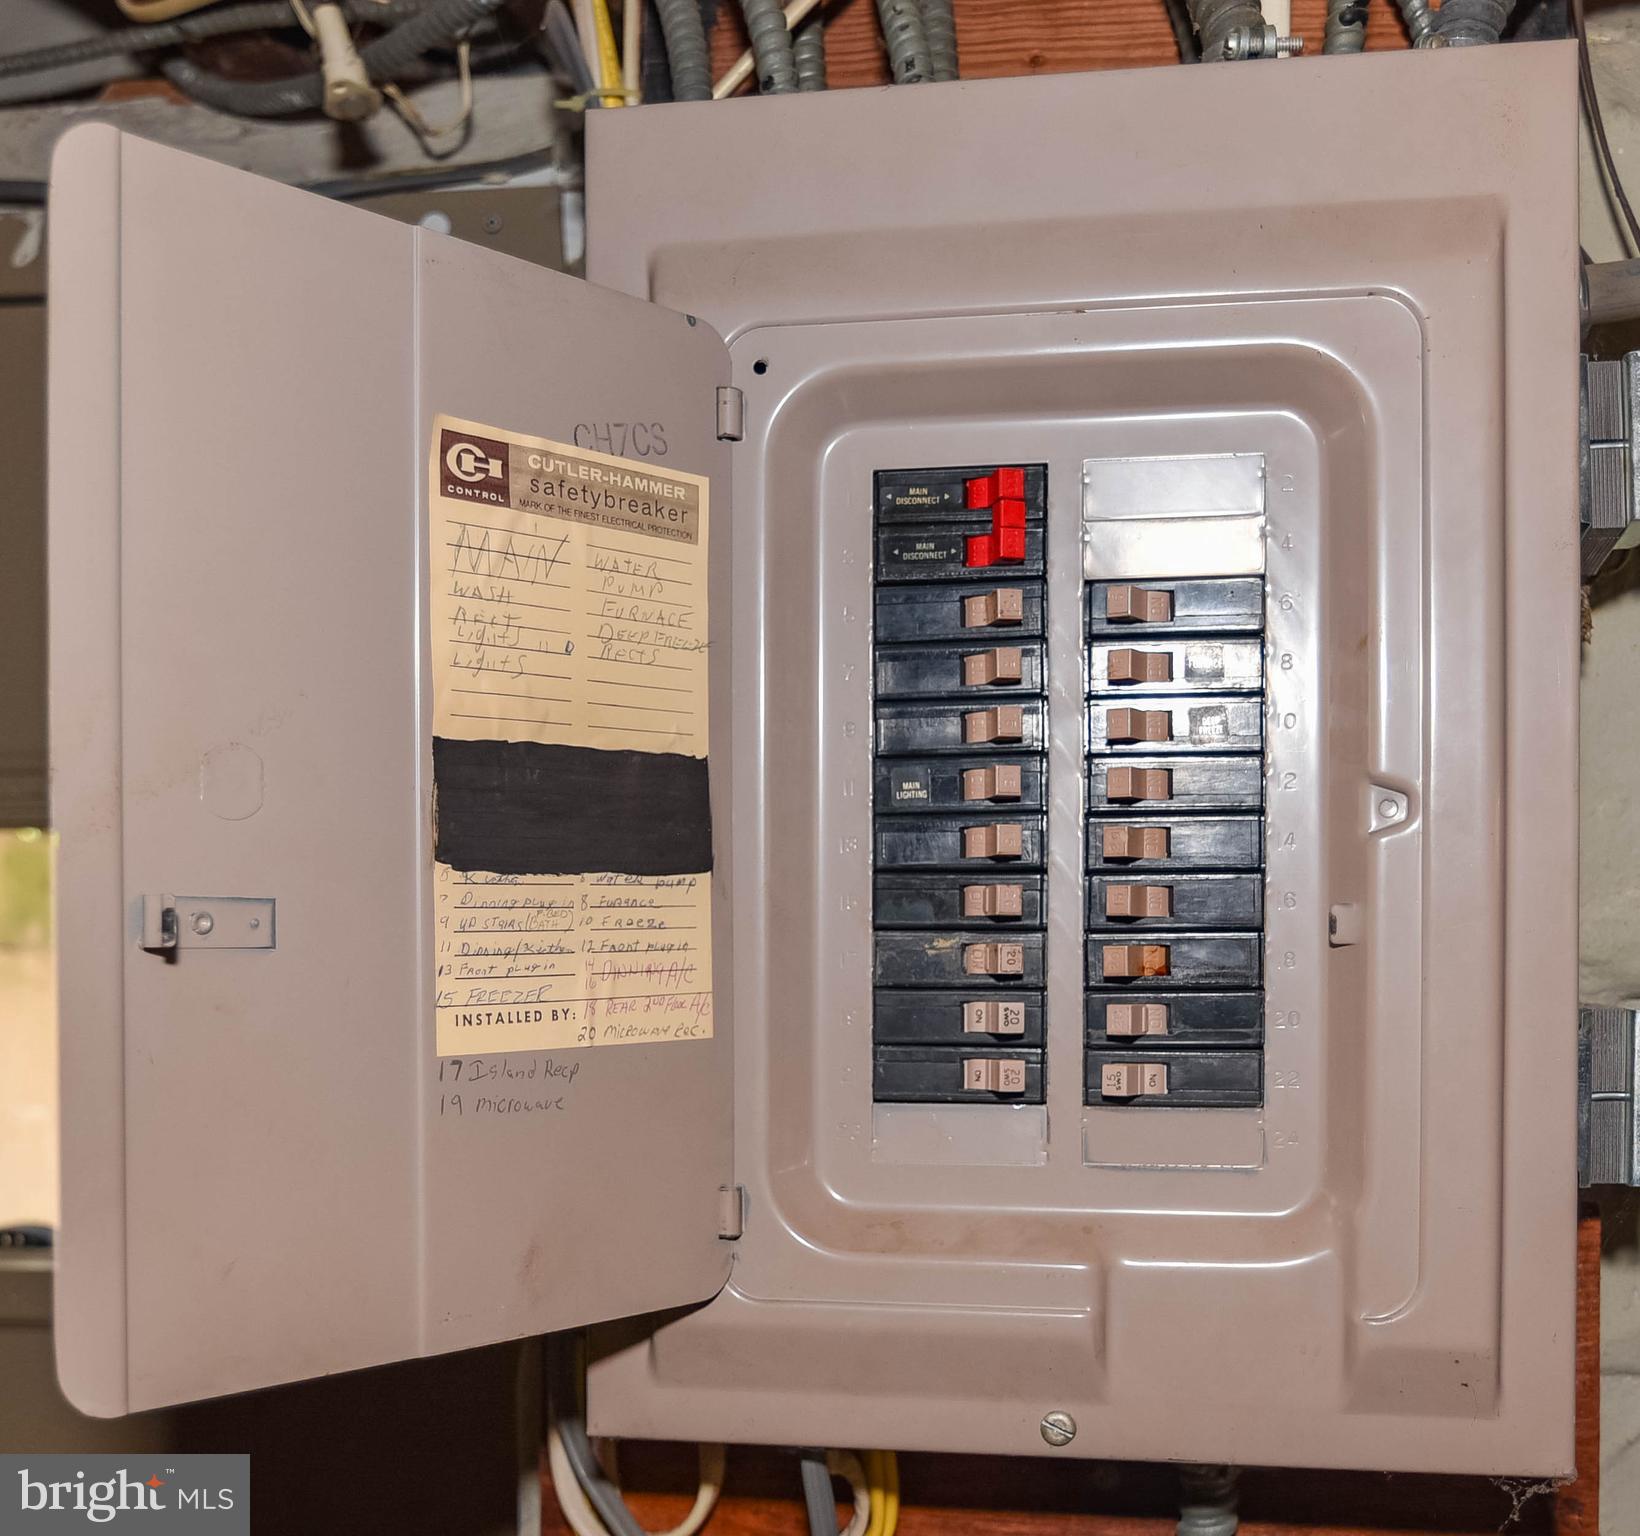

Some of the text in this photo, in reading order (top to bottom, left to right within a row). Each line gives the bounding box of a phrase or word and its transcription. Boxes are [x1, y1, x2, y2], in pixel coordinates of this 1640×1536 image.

[573, 422, 669, 456] CH7CS
[527, 453, 687, 500] CUTLER-HAMMER
[447, 484, 504, 503] CONTROL
[895, 495, 940, 505] DISCONNECT
[908, 487, 928, 495] MAIN
[529, 477, 689, 524] safetybreaker
[519, 498, 693, 541] MARK OF THE FINEST ELECTRICAL PROTECTION
[902, 550, 947, 560] DISCONNECT
[915, 542, 935, 550] MAIN
[593, 552, 661, 580] WATER
[453, 580, 514, 603] WASH
[1280, 593, 1294, 612] 6
[1280, 652, 1294, 671] 8
[1277, 712, 1298, 730] 10
[902, 781, 921, 790] MAIN
[1277, 771, 1298, 791] 12
[896, 789, 928, 800] LIGHTING
[580, 893, 588, 911] 8
[440, 915, 449, 929] 9
[581, 939, 595, 953] 12
[1006, 950, 1018, 966] 20
[438, 963, 452, 978] 13
[435, 983, 553, 1009] 15 FREEZER
[583, 998, 597, 1019] 18
[605, 997, 638, 1017] REAR
[974, 1008, 984, 1024] ON
[1009, 1008, 1020, 1026] 20
[455, 1007, 576, 1028] INSTALLED BY:
[1275, 1010, 1300, 1029] 20
[577, 1025, 596, 1042] 20
[439, 1059, 463, 1082] 17
[468, 1058, 538, 1082] Island
[974, 1069, 982, 1083] ON
[1009, 1069, 1021, 1085] 20
[1106, 1073, 1116, 1088] 15
[1148, 1073, 1158, 1088] ON
[1274, 1071, 1300, 1089] 22
[440, 1094, 463, 1116] 19
